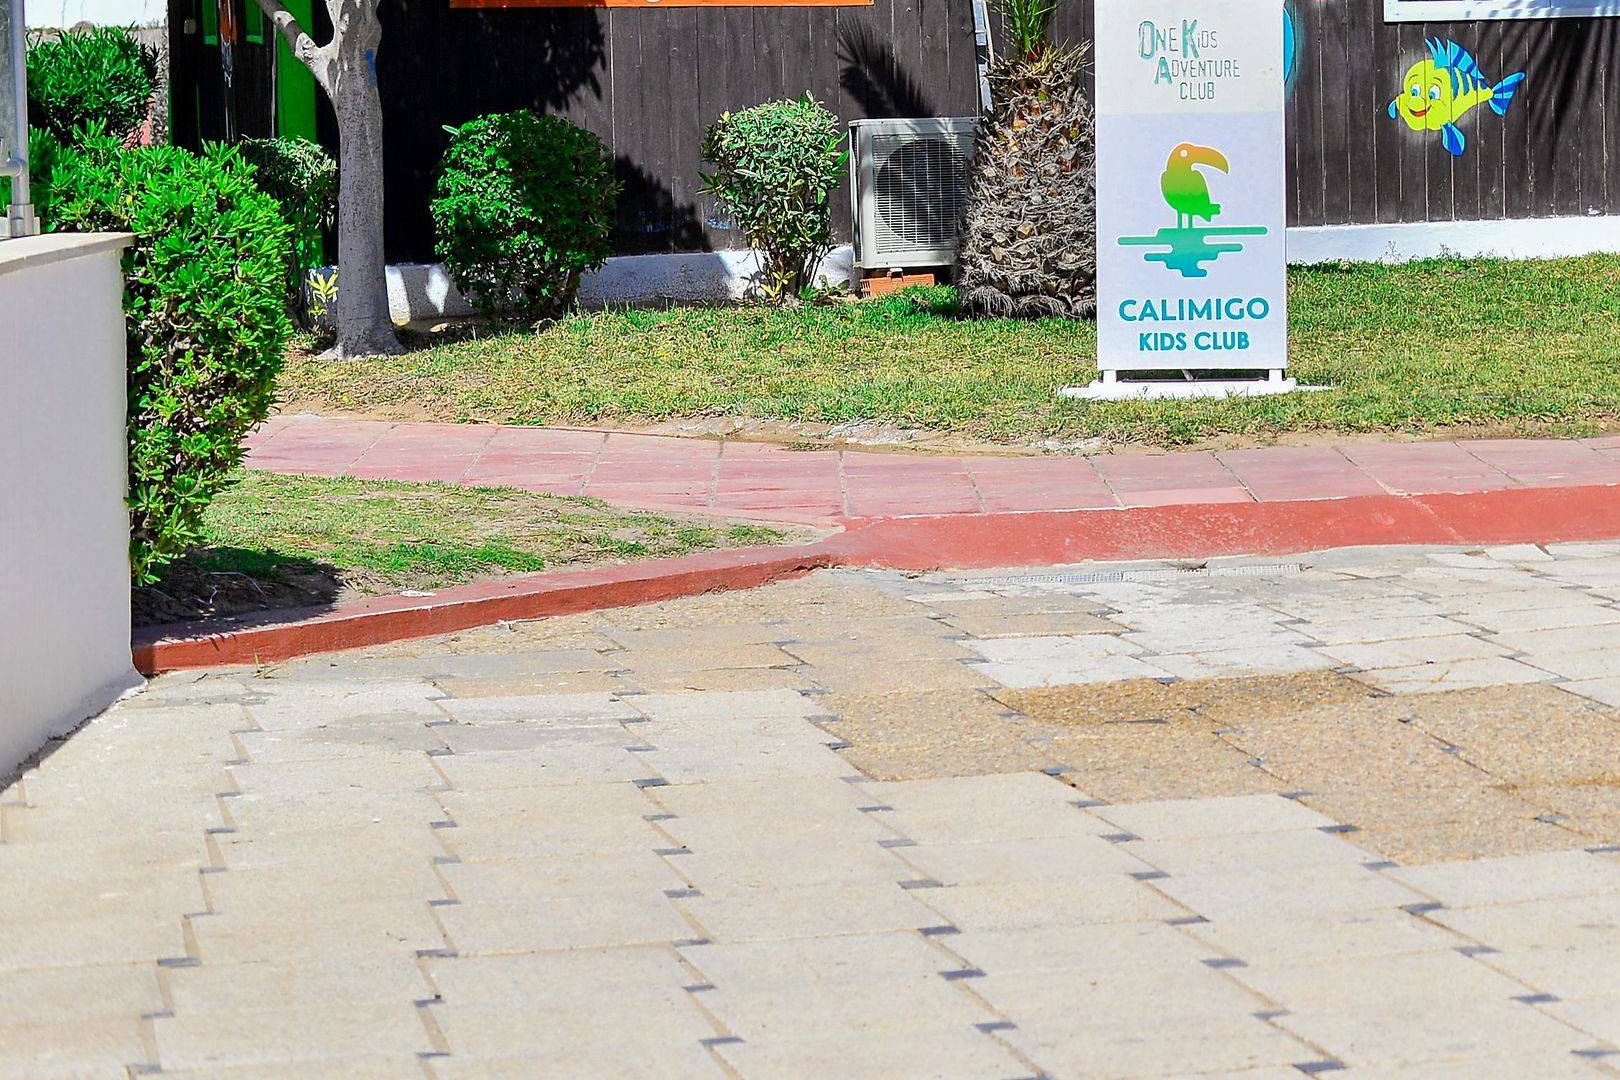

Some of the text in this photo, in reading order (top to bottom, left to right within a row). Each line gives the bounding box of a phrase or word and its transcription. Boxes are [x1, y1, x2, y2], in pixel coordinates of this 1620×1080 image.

[1138, 20, 1178, 59] ONE
[1154, 56, 1240, 85] ADVENTURE
[1179, 81, 1215, 100] CLUB
[1118, 297, 1270, 322] CALIMIGO
[1139, 331, 1250, 351] KIDS CLUB
